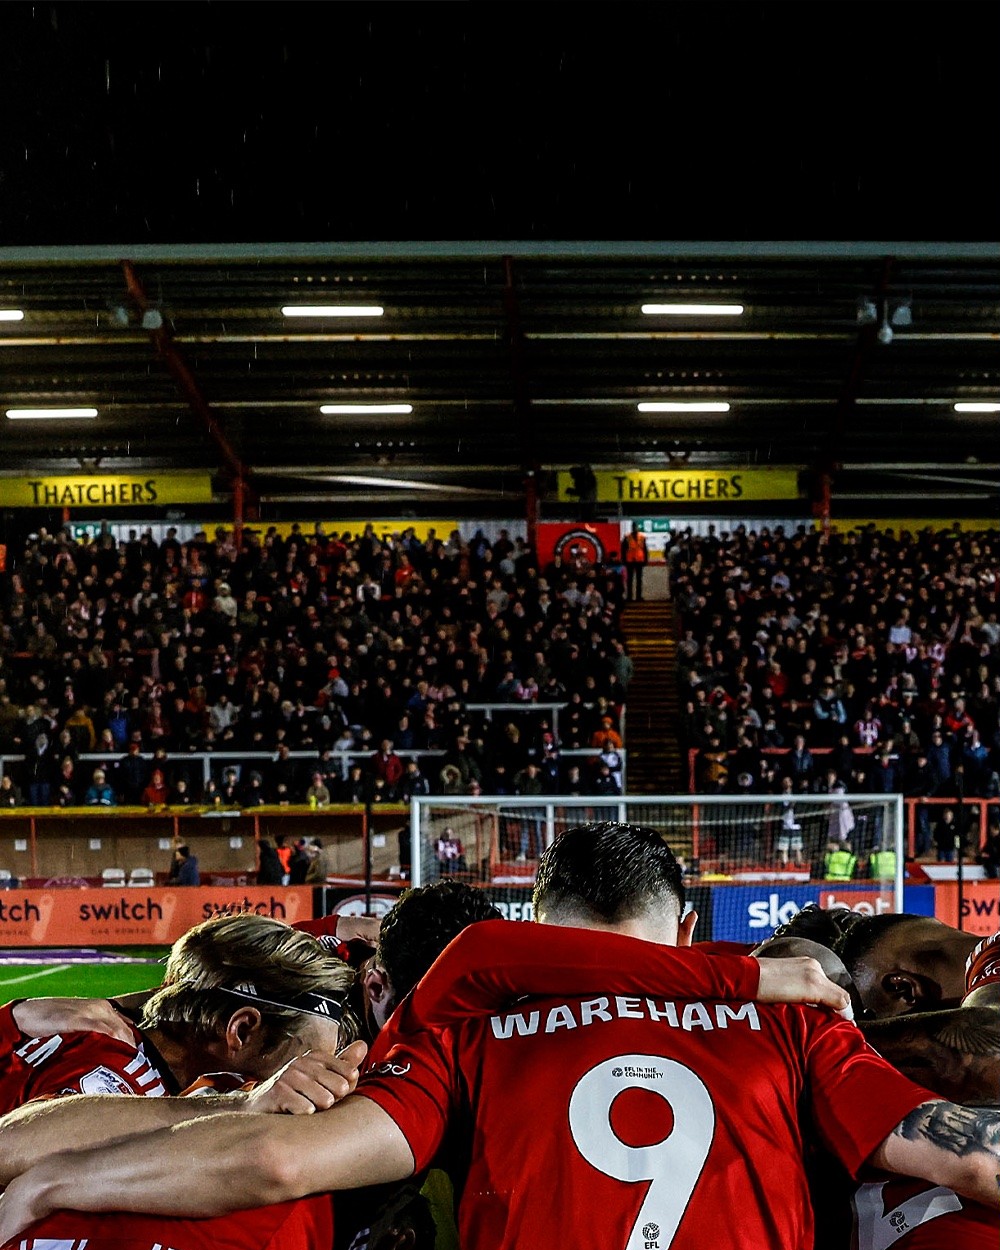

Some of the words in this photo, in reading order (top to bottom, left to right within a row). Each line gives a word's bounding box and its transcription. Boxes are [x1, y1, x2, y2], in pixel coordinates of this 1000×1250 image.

[27, 480, 159, 505] THATCHERS
[612, 474, 744, 499] THATCHERS
[79, 897, 163, 921] switch
[491, 996, 761, 1039] WAREHAM
[644, 1241, 660, 1250] EFL
